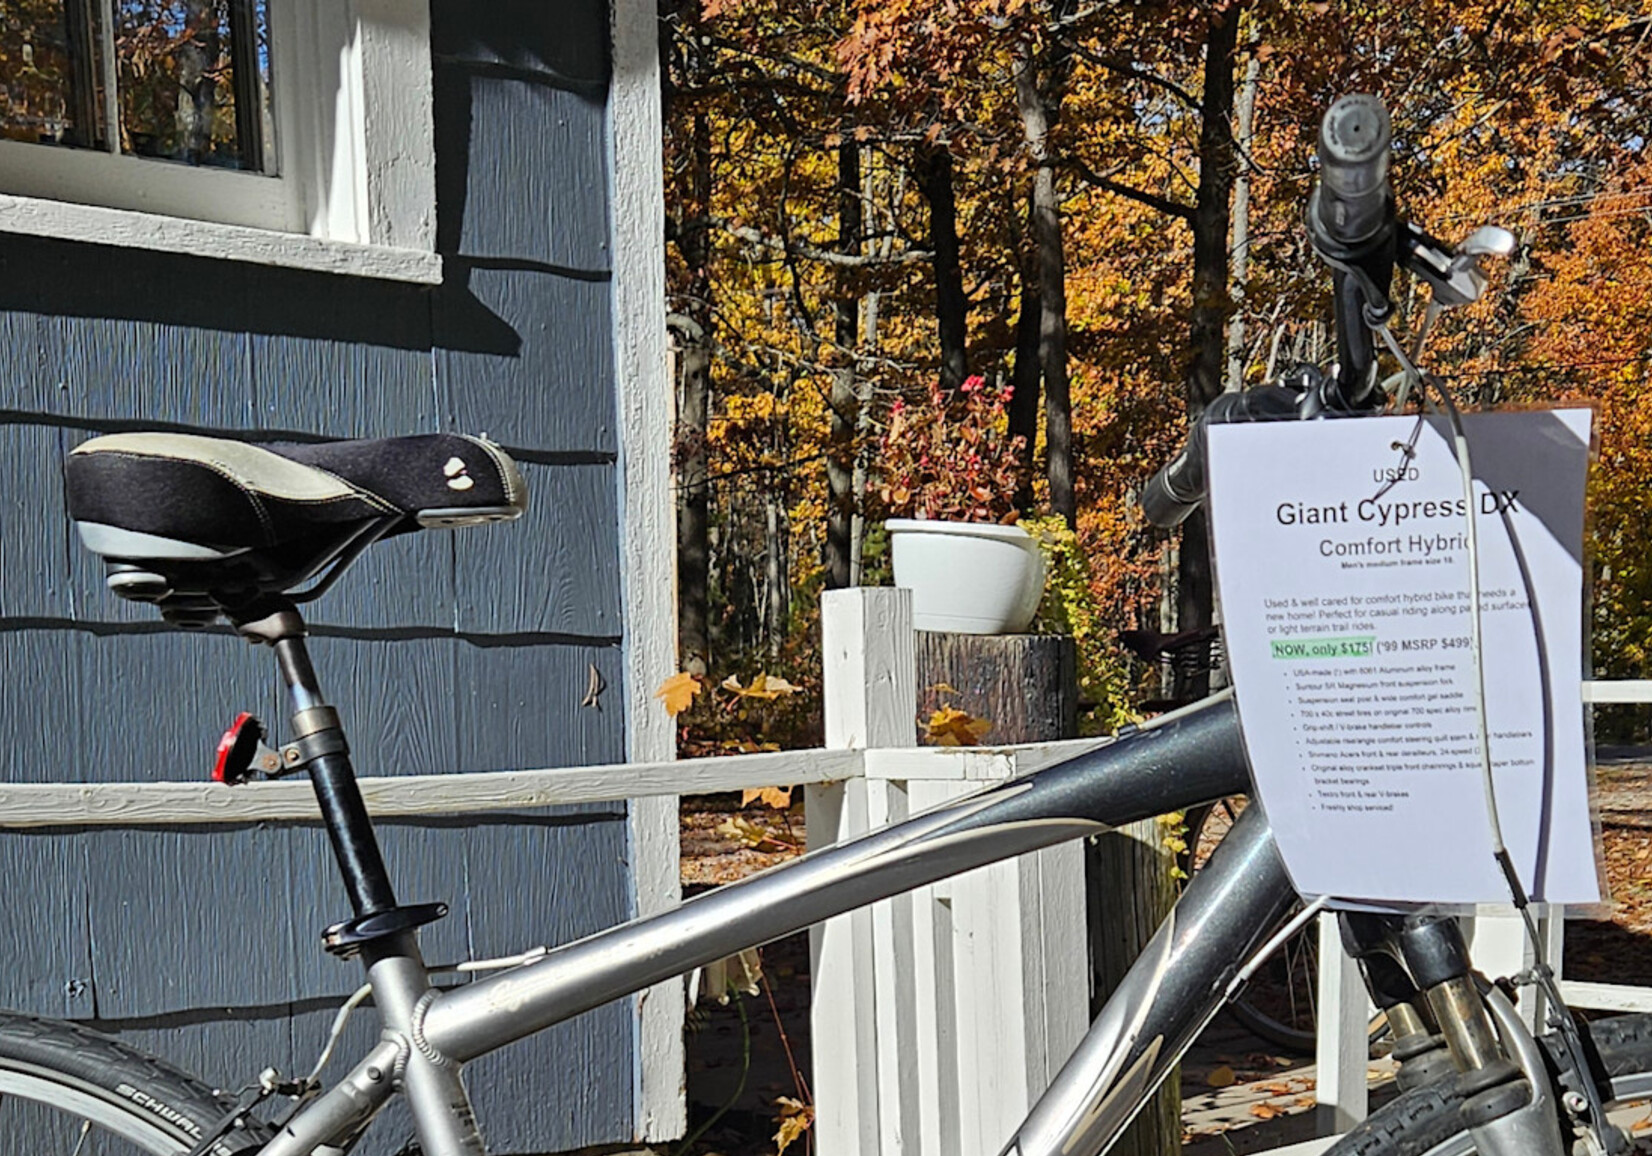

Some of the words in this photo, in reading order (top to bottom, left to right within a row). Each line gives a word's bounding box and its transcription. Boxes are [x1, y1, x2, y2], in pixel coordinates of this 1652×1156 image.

[1373, 467, 1419, 483] USED
[1277, 502, 1348, 525] Giant
[1358, 499, 1466, 527] Cypress
[1481, 490, 1519, 515] DX
[1320, 537, 1401, 557] Comfort
[1264, 599, 1288, 609] Used
[1291, 598, 1298, 607] &
[1300, 597, 1319, 607] well
[1321, 597, 1348, 606] cared
[1350, 596, 1363, 605] for
[1365, 594, 1401, 605] comfort
[1403, 592, 1432, 604] hybrid
[1434, 592, 1454, 601] bike
[1456, 591, 1474, 601] tha
[1510, 589, 1516, 597] a
[1318, 609, 1352, 619] Perfect
[1354, 608, 1367, 618] for
[1369, 607, 1399, 618] casual
[1402, 605, 1428, 617] riding
[1431, 605, 1457, 615] along
[1491, 600, 1530, 611] surface
[1267, 626, 1277, 634] or
[1279, 624, 1298, 636] light
[1300, 624, 1330, 633] terrain
[1332, 622, 1349, 632] trail
[1311, 643, 1337, 657] only
[1401, 638, 1438, 651] MSRP
